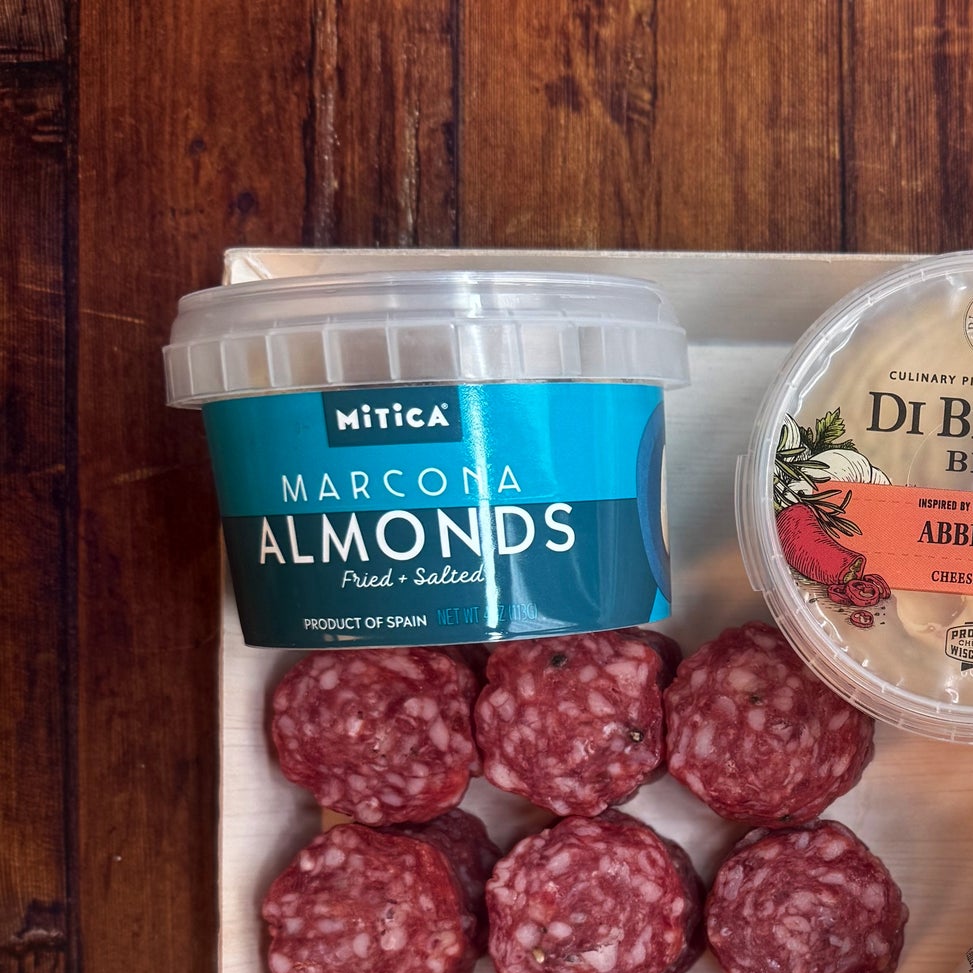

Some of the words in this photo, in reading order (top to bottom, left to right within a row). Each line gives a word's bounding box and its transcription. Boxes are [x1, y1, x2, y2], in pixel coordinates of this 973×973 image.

[889, 370, 956, 385] CULINARY
[866, 391, 926, 436] DI
[281, 465, 522, 502] MARCONA
[918, 498, 957, 511] INSPIRED
[960, 501, 970, 512] BY
[259, 503, 576, 564] ALMONDS
[341, 567, 394, 589] Fried
[398, 575, 408, 585] +
[413, 565, 485, 586] Salted
[304, 617, 361, 631] PRODUCT
[365, 616, 384, 629] OF
[387, 614, 428, 629] SPAIN
[437, 608, 460, 625] NET
[463, 606, 479, 624] WT
